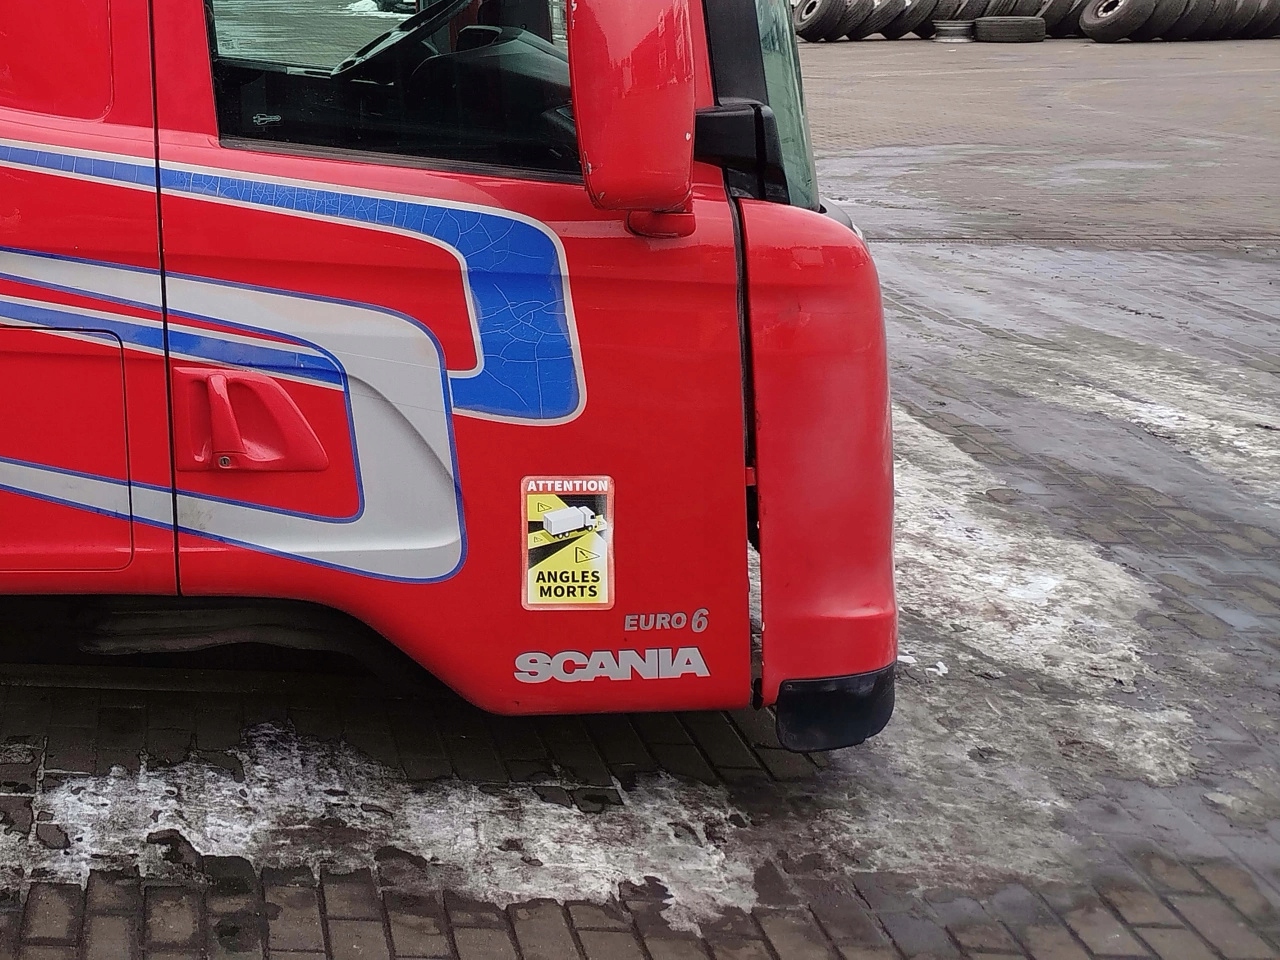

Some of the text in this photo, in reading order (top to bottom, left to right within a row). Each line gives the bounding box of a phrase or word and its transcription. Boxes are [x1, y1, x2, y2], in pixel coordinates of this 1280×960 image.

[527, 480, 608, 492] ATTENTION
[535, 570, 600, 584] ANGLES
[539, 585, 598, 598] MORTS
[624, 608, 710, 633] EURO 6
[514, 646, 711, 683] SCANIA
